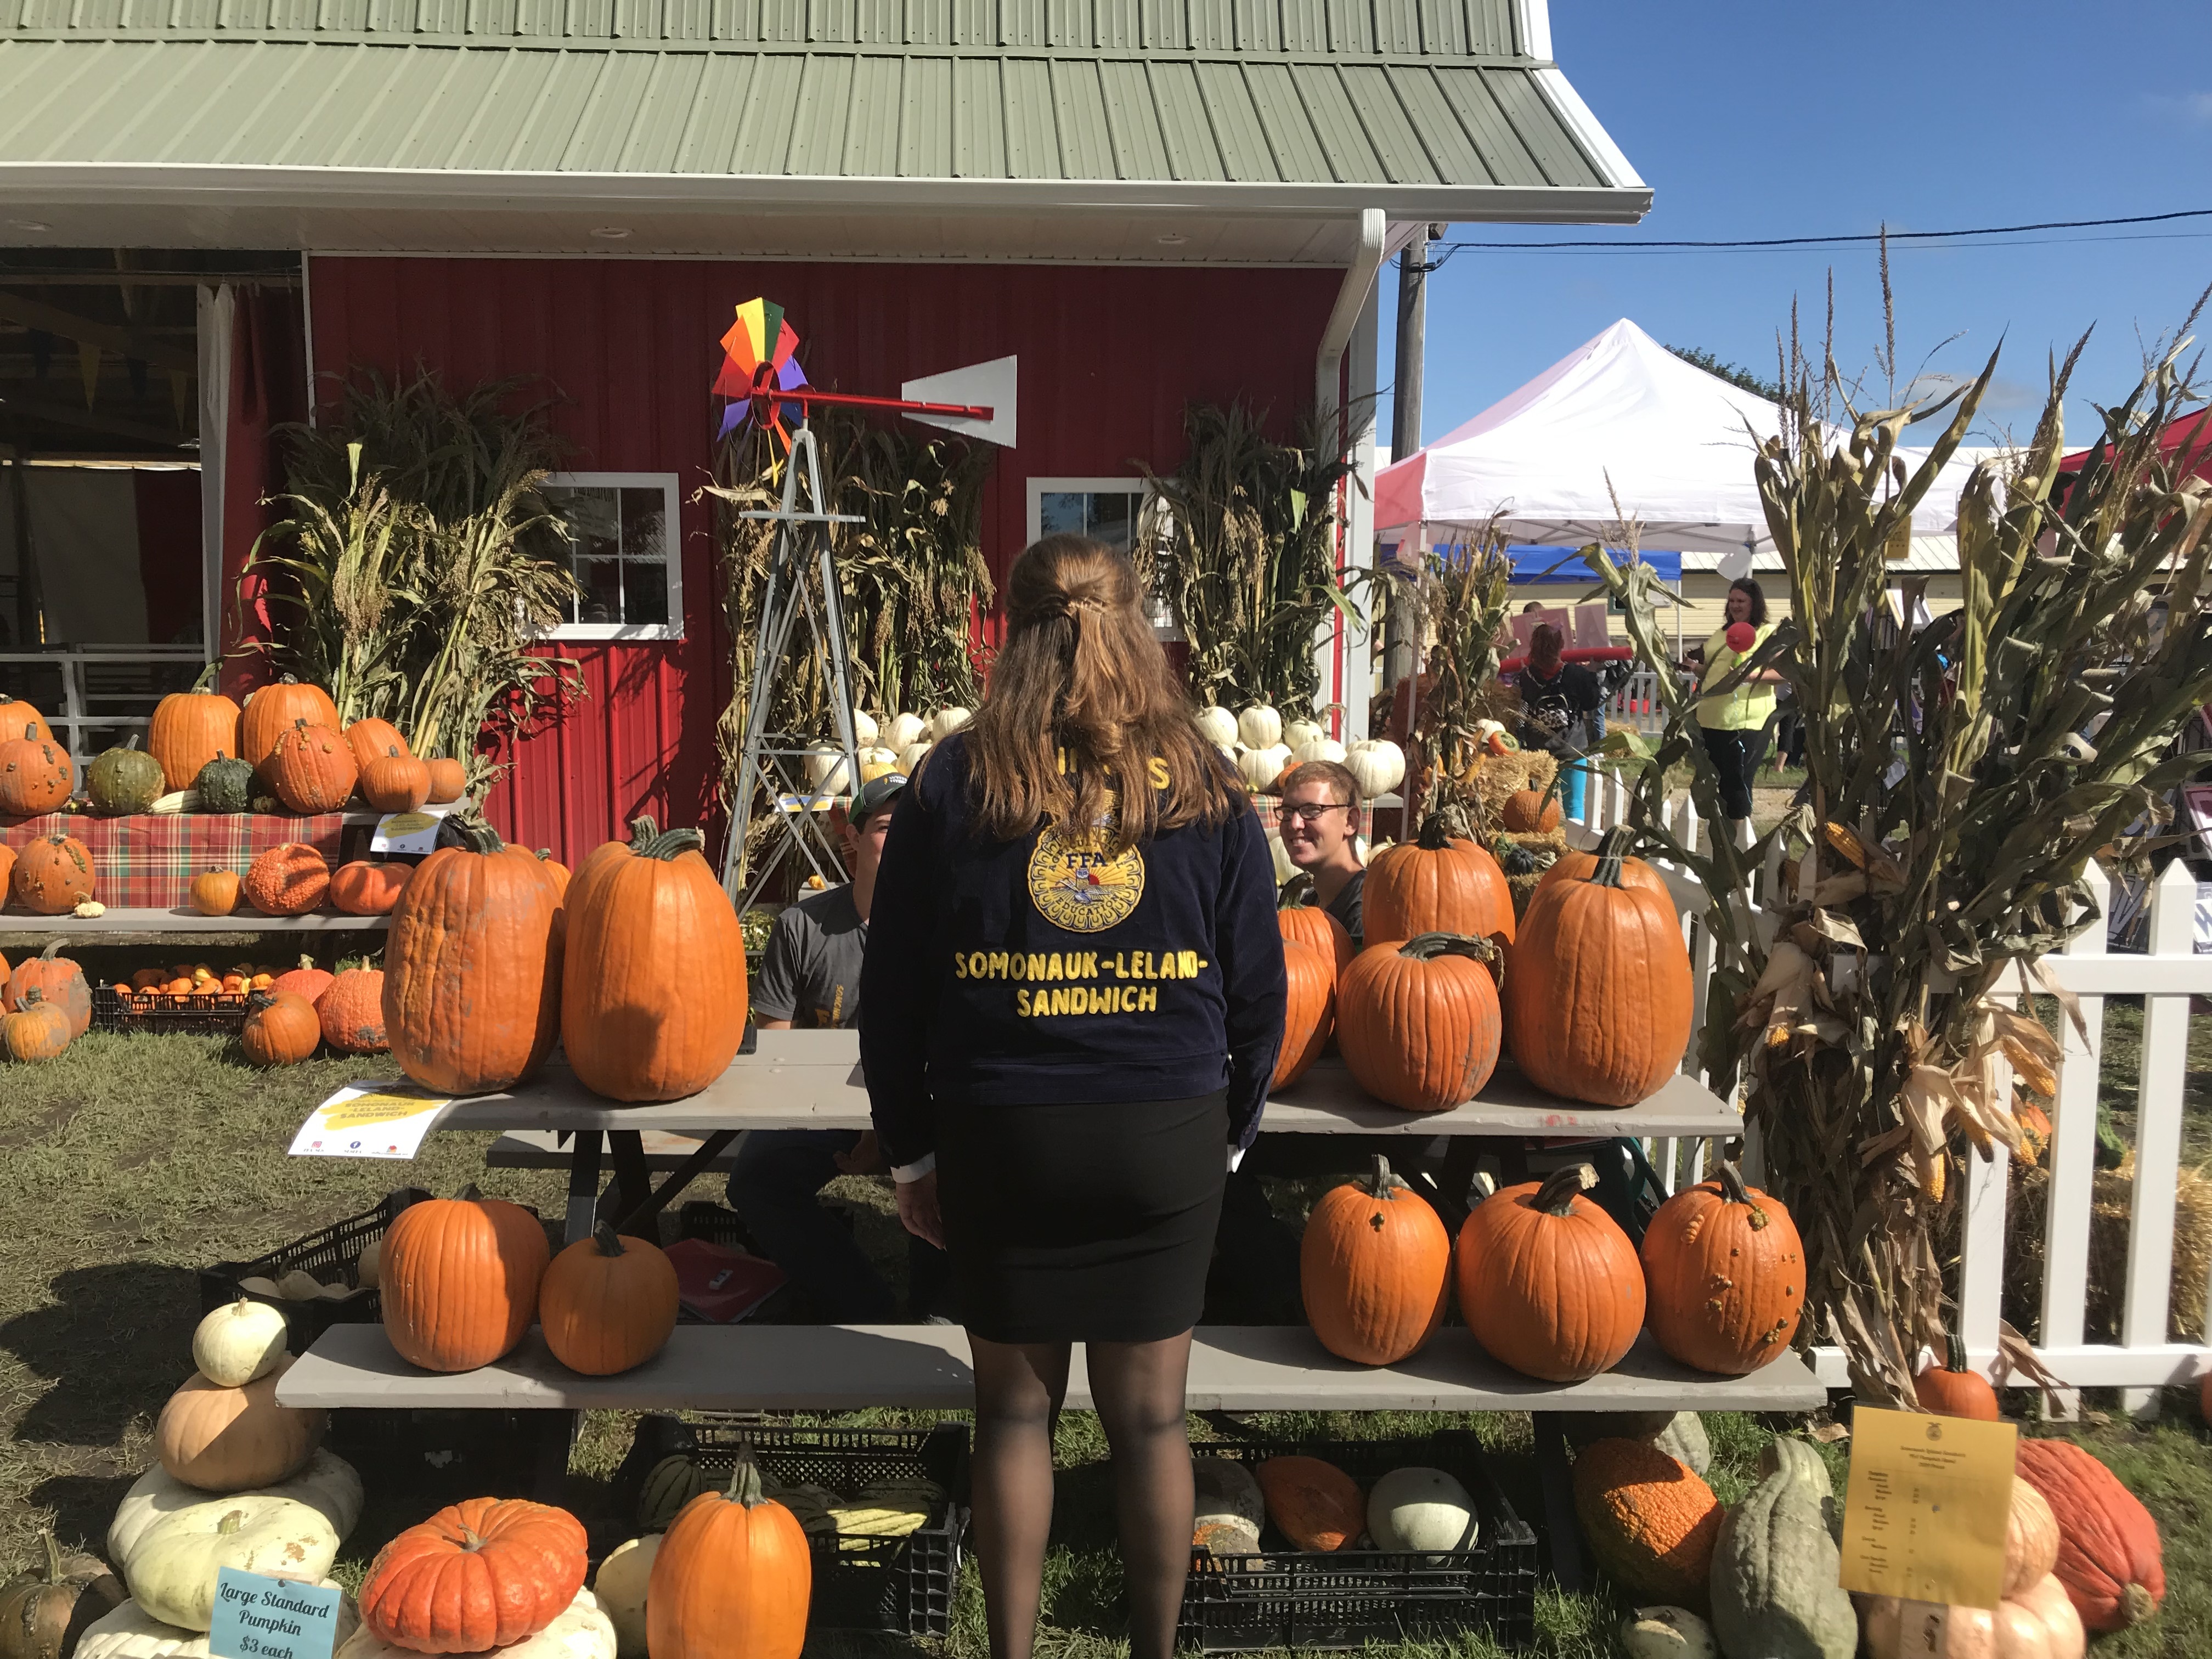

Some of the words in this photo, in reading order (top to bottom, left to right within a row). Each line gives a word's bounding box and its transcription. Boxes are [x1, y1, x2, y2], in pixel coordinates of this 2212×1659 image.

[1066, 852, 1108, 868] FFA
[1056, 897, 1120, 916] EDUCATION
[1017, 986, 1157, 1017] SANDWICH
[221, 1582, 258, 1606] Large
[261, 1591, 330, 1618] Standard
[239, 1610, 301, 1636] Pumpkin
[240, 1635, 259, 1652] $3
[261, 1645, 293, 1659] each
